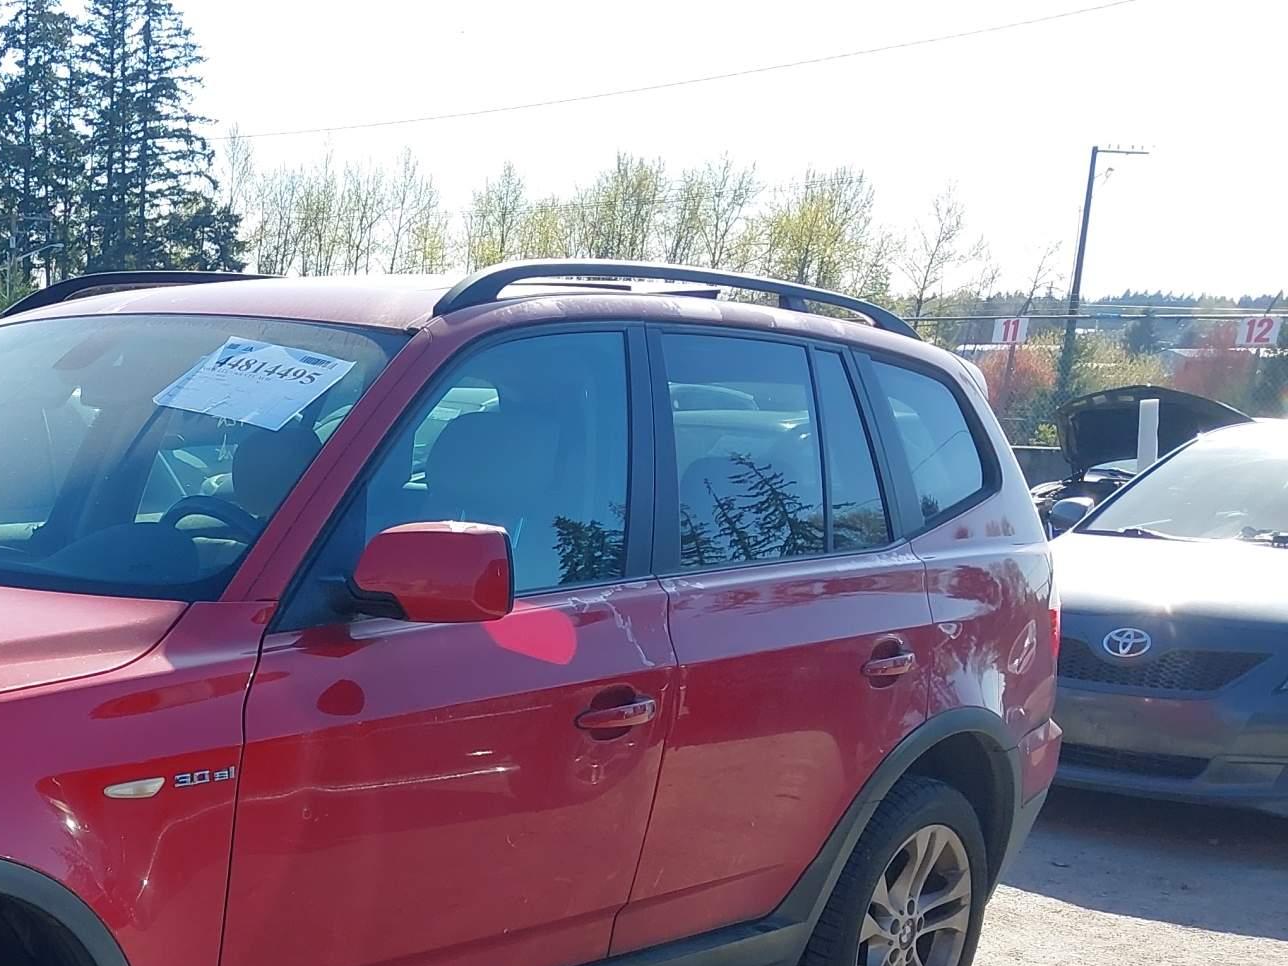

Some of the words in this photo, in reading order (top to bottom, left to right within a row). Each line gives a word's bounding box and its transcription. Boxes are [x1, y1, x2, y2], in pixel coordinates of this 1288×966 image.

[1002, 319, 1020, 342] 11
[1246, 318, 1274, 343] 12
[216, 355, 323, 385] 44814495
